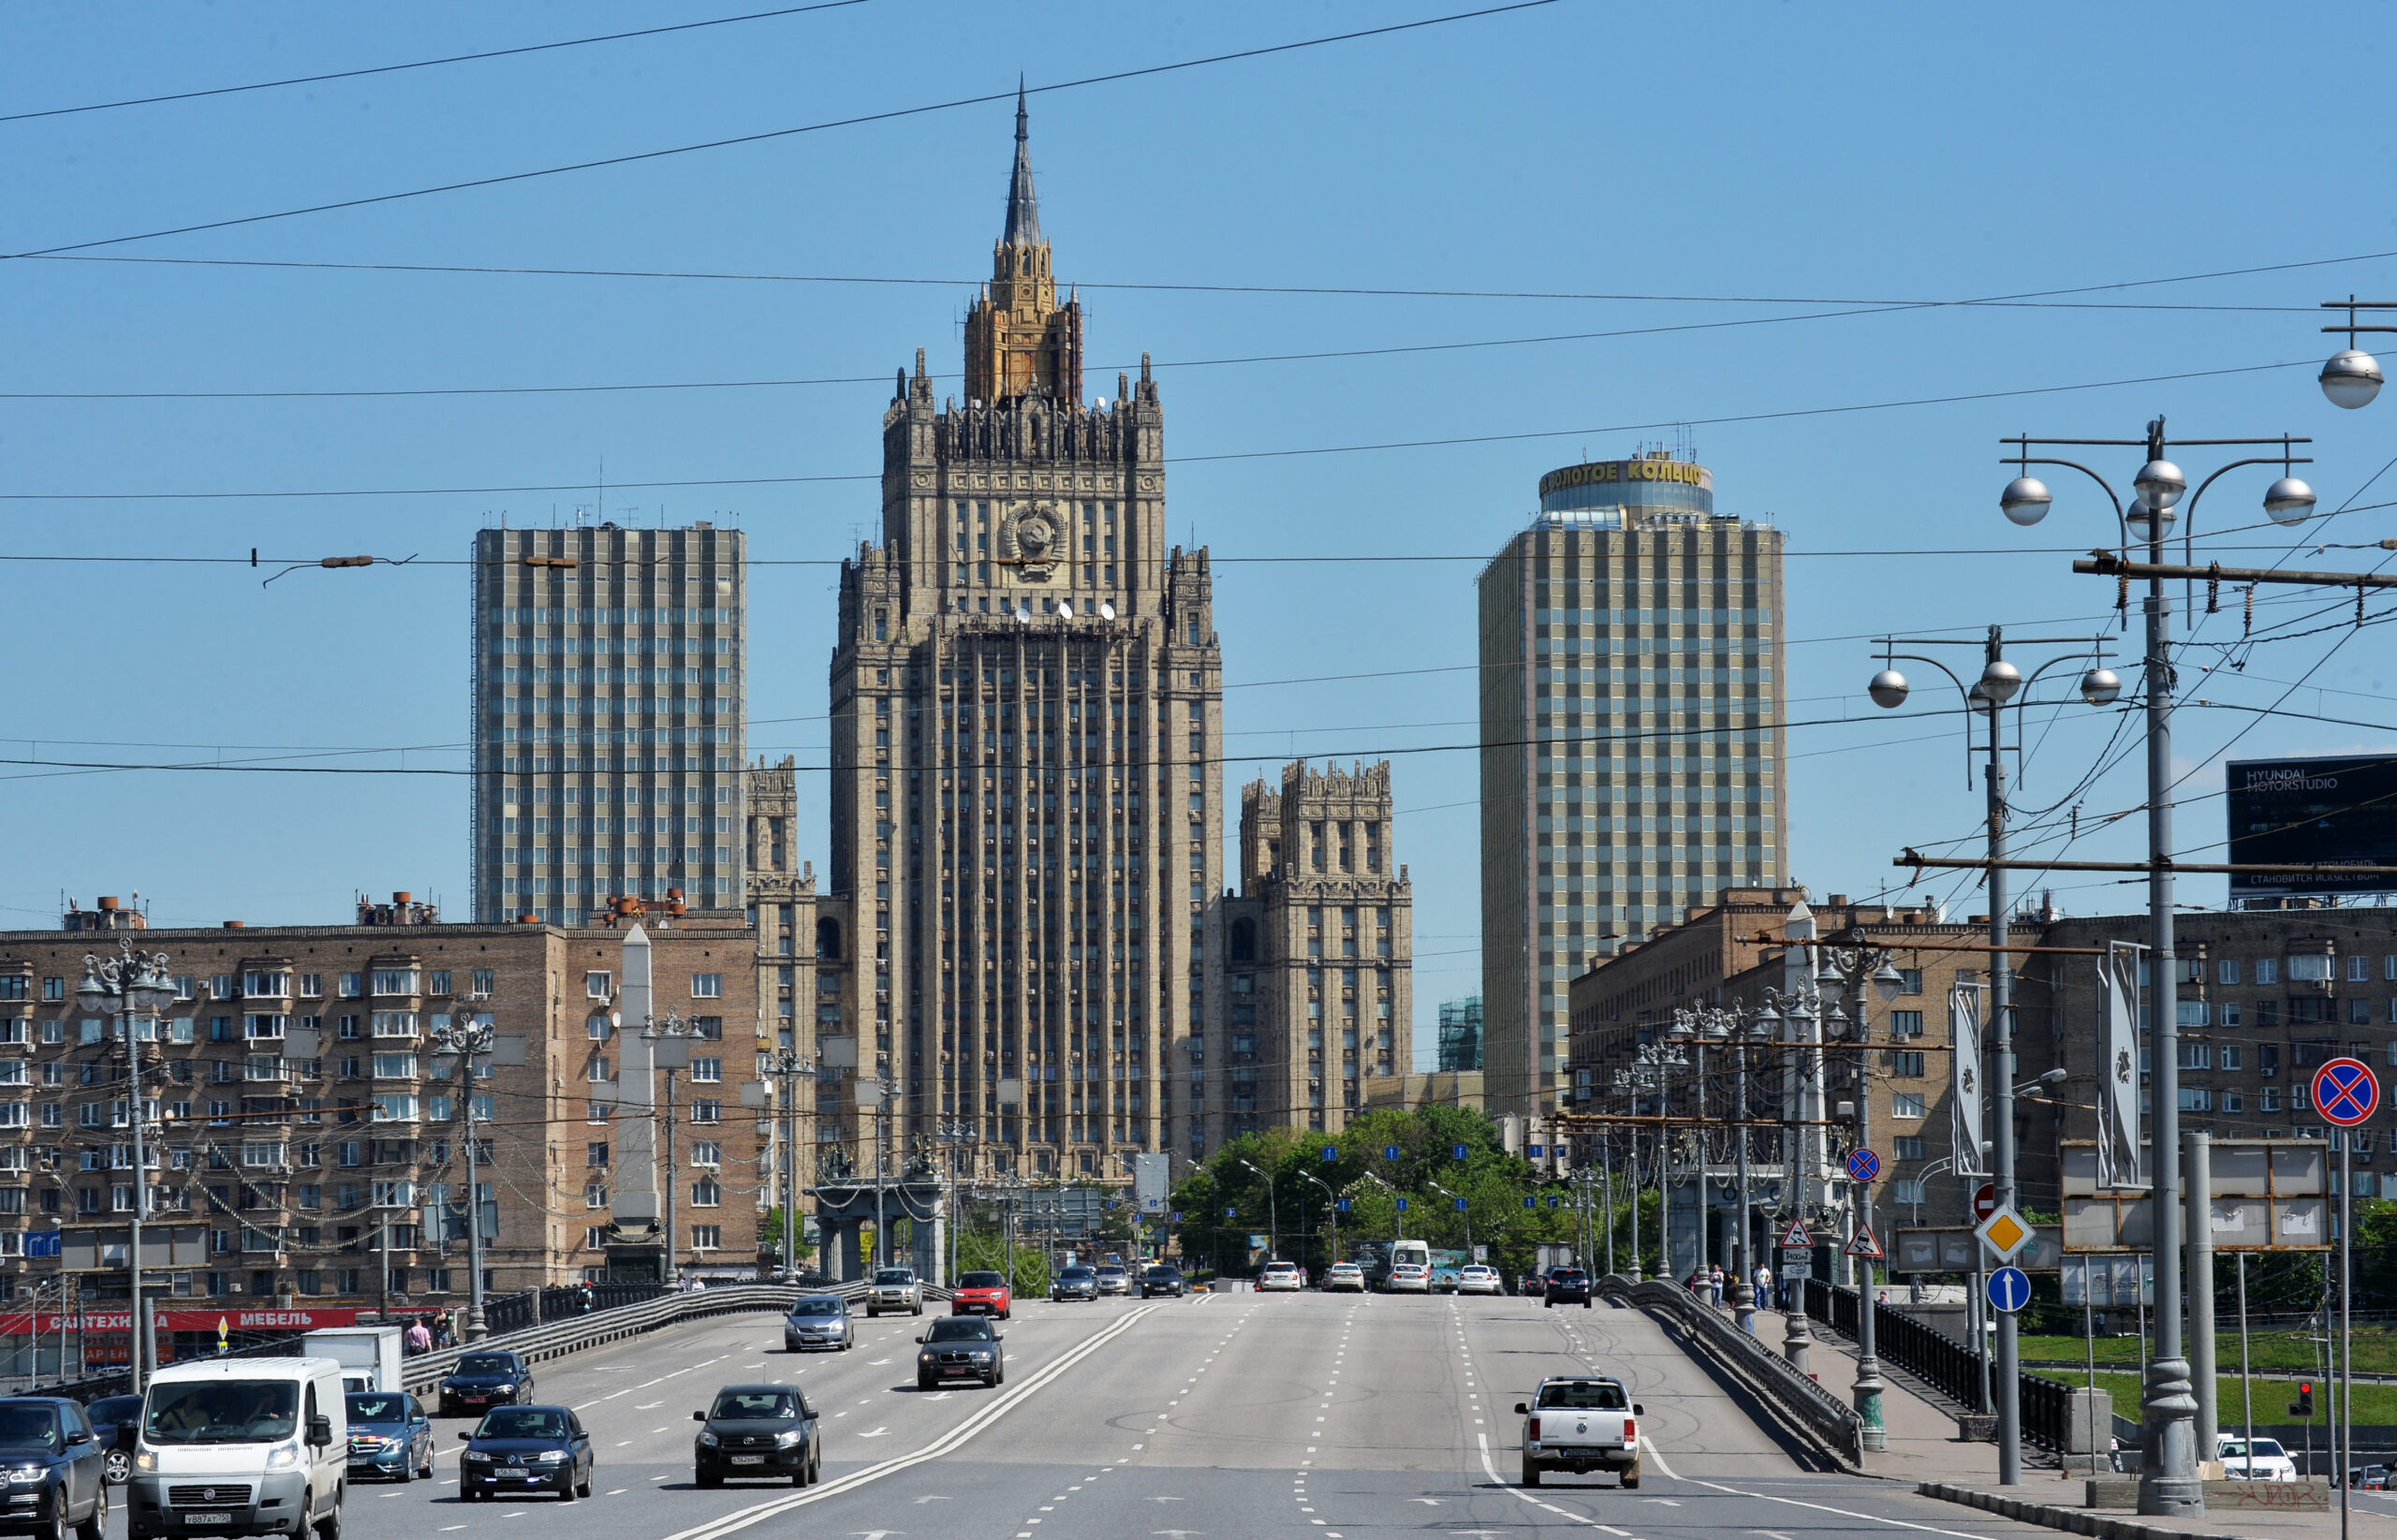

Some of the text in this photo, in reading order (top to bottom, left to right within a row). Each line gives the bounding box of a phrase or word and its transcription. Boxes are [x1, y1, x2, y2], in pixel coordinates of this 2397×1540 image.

[1550, 463, 1618, 490] ЗОЛОТОЕ
[1627, 462, 1701, 485] КОЛЬЦО
[2246, 769, 2305, 782] HYUNDAI
[2246, 777, 2338, 793] MOTORSTUDIO
[2251, 873, 2313, 885] СТАНОВИТСЯ
[50, 1313, 313, 1329] САНТЕХНА МЕБЕЛЬ
